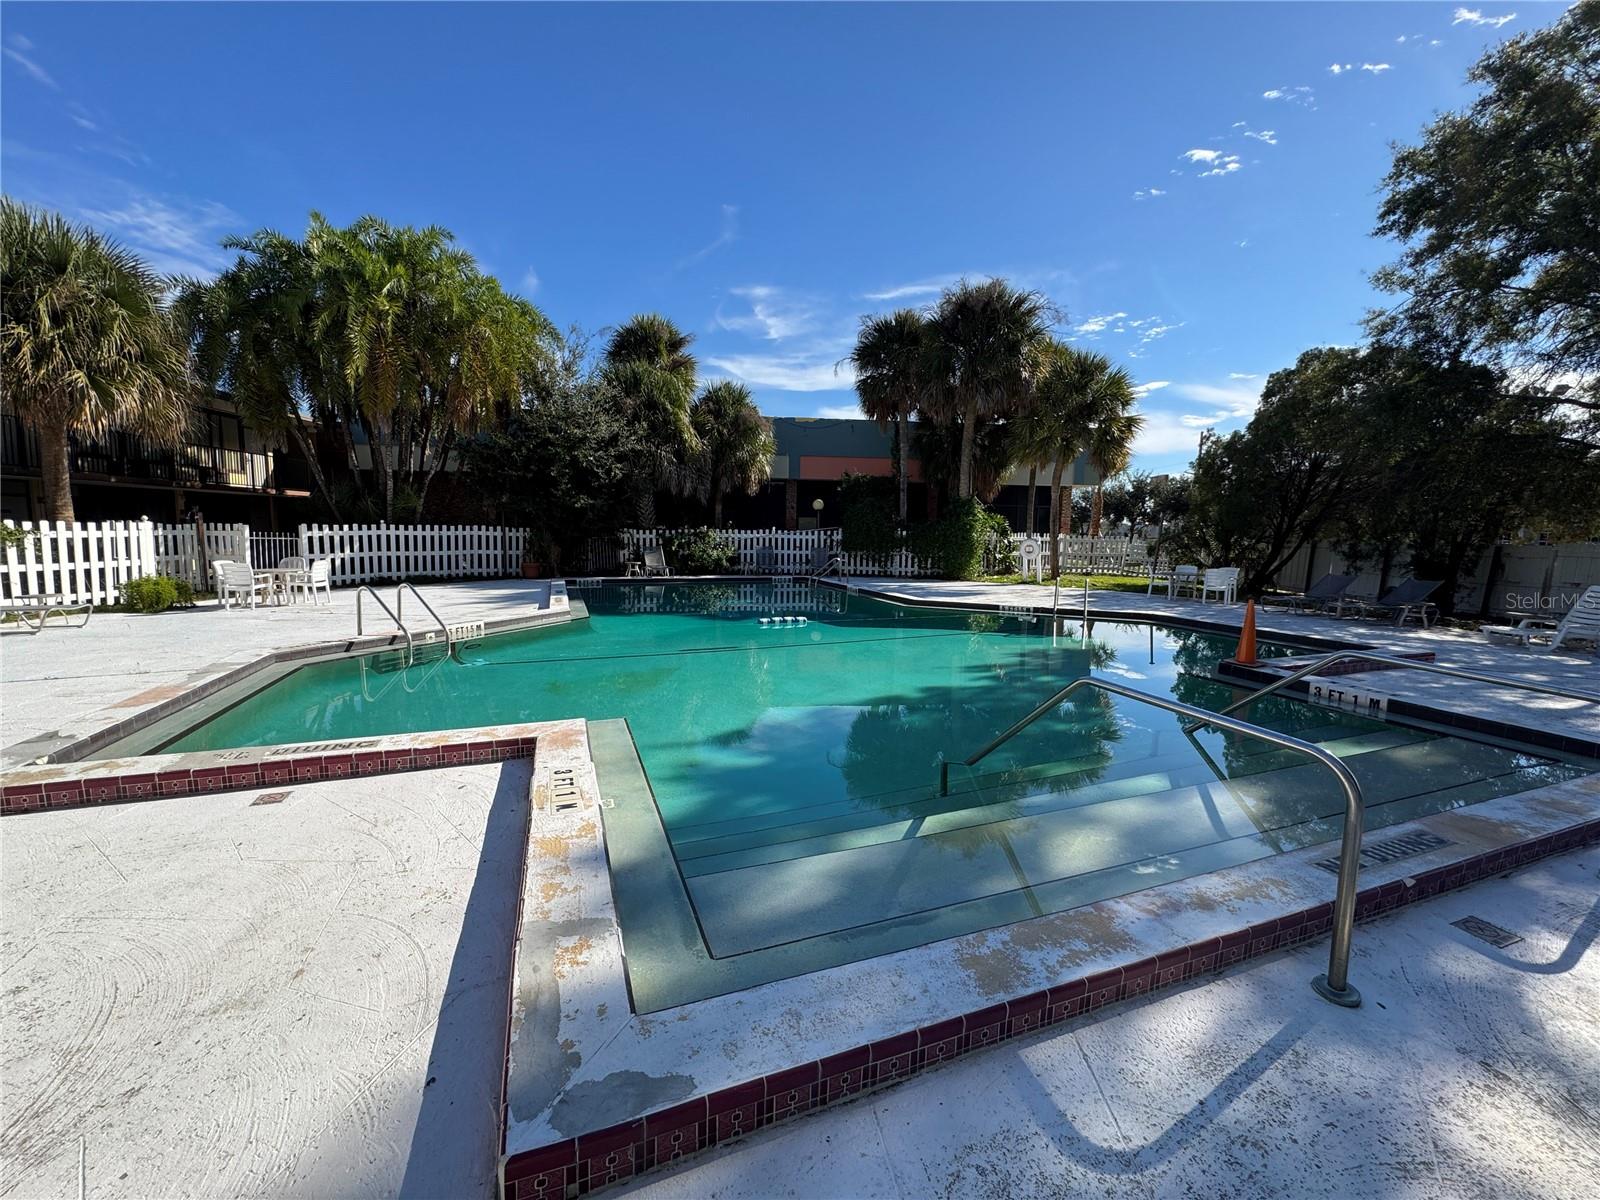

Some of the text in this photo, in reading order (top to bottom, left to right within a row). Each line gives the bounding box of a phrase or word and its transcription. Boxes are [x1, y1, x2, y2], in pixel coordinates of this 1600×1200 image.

[455, 626, 464, 635] FT
[1314, 686, 1381, 709] 3 FT 1 M
[553, 777, 575, 788] FT
[1360, 831, 1450, 863] DIVING
